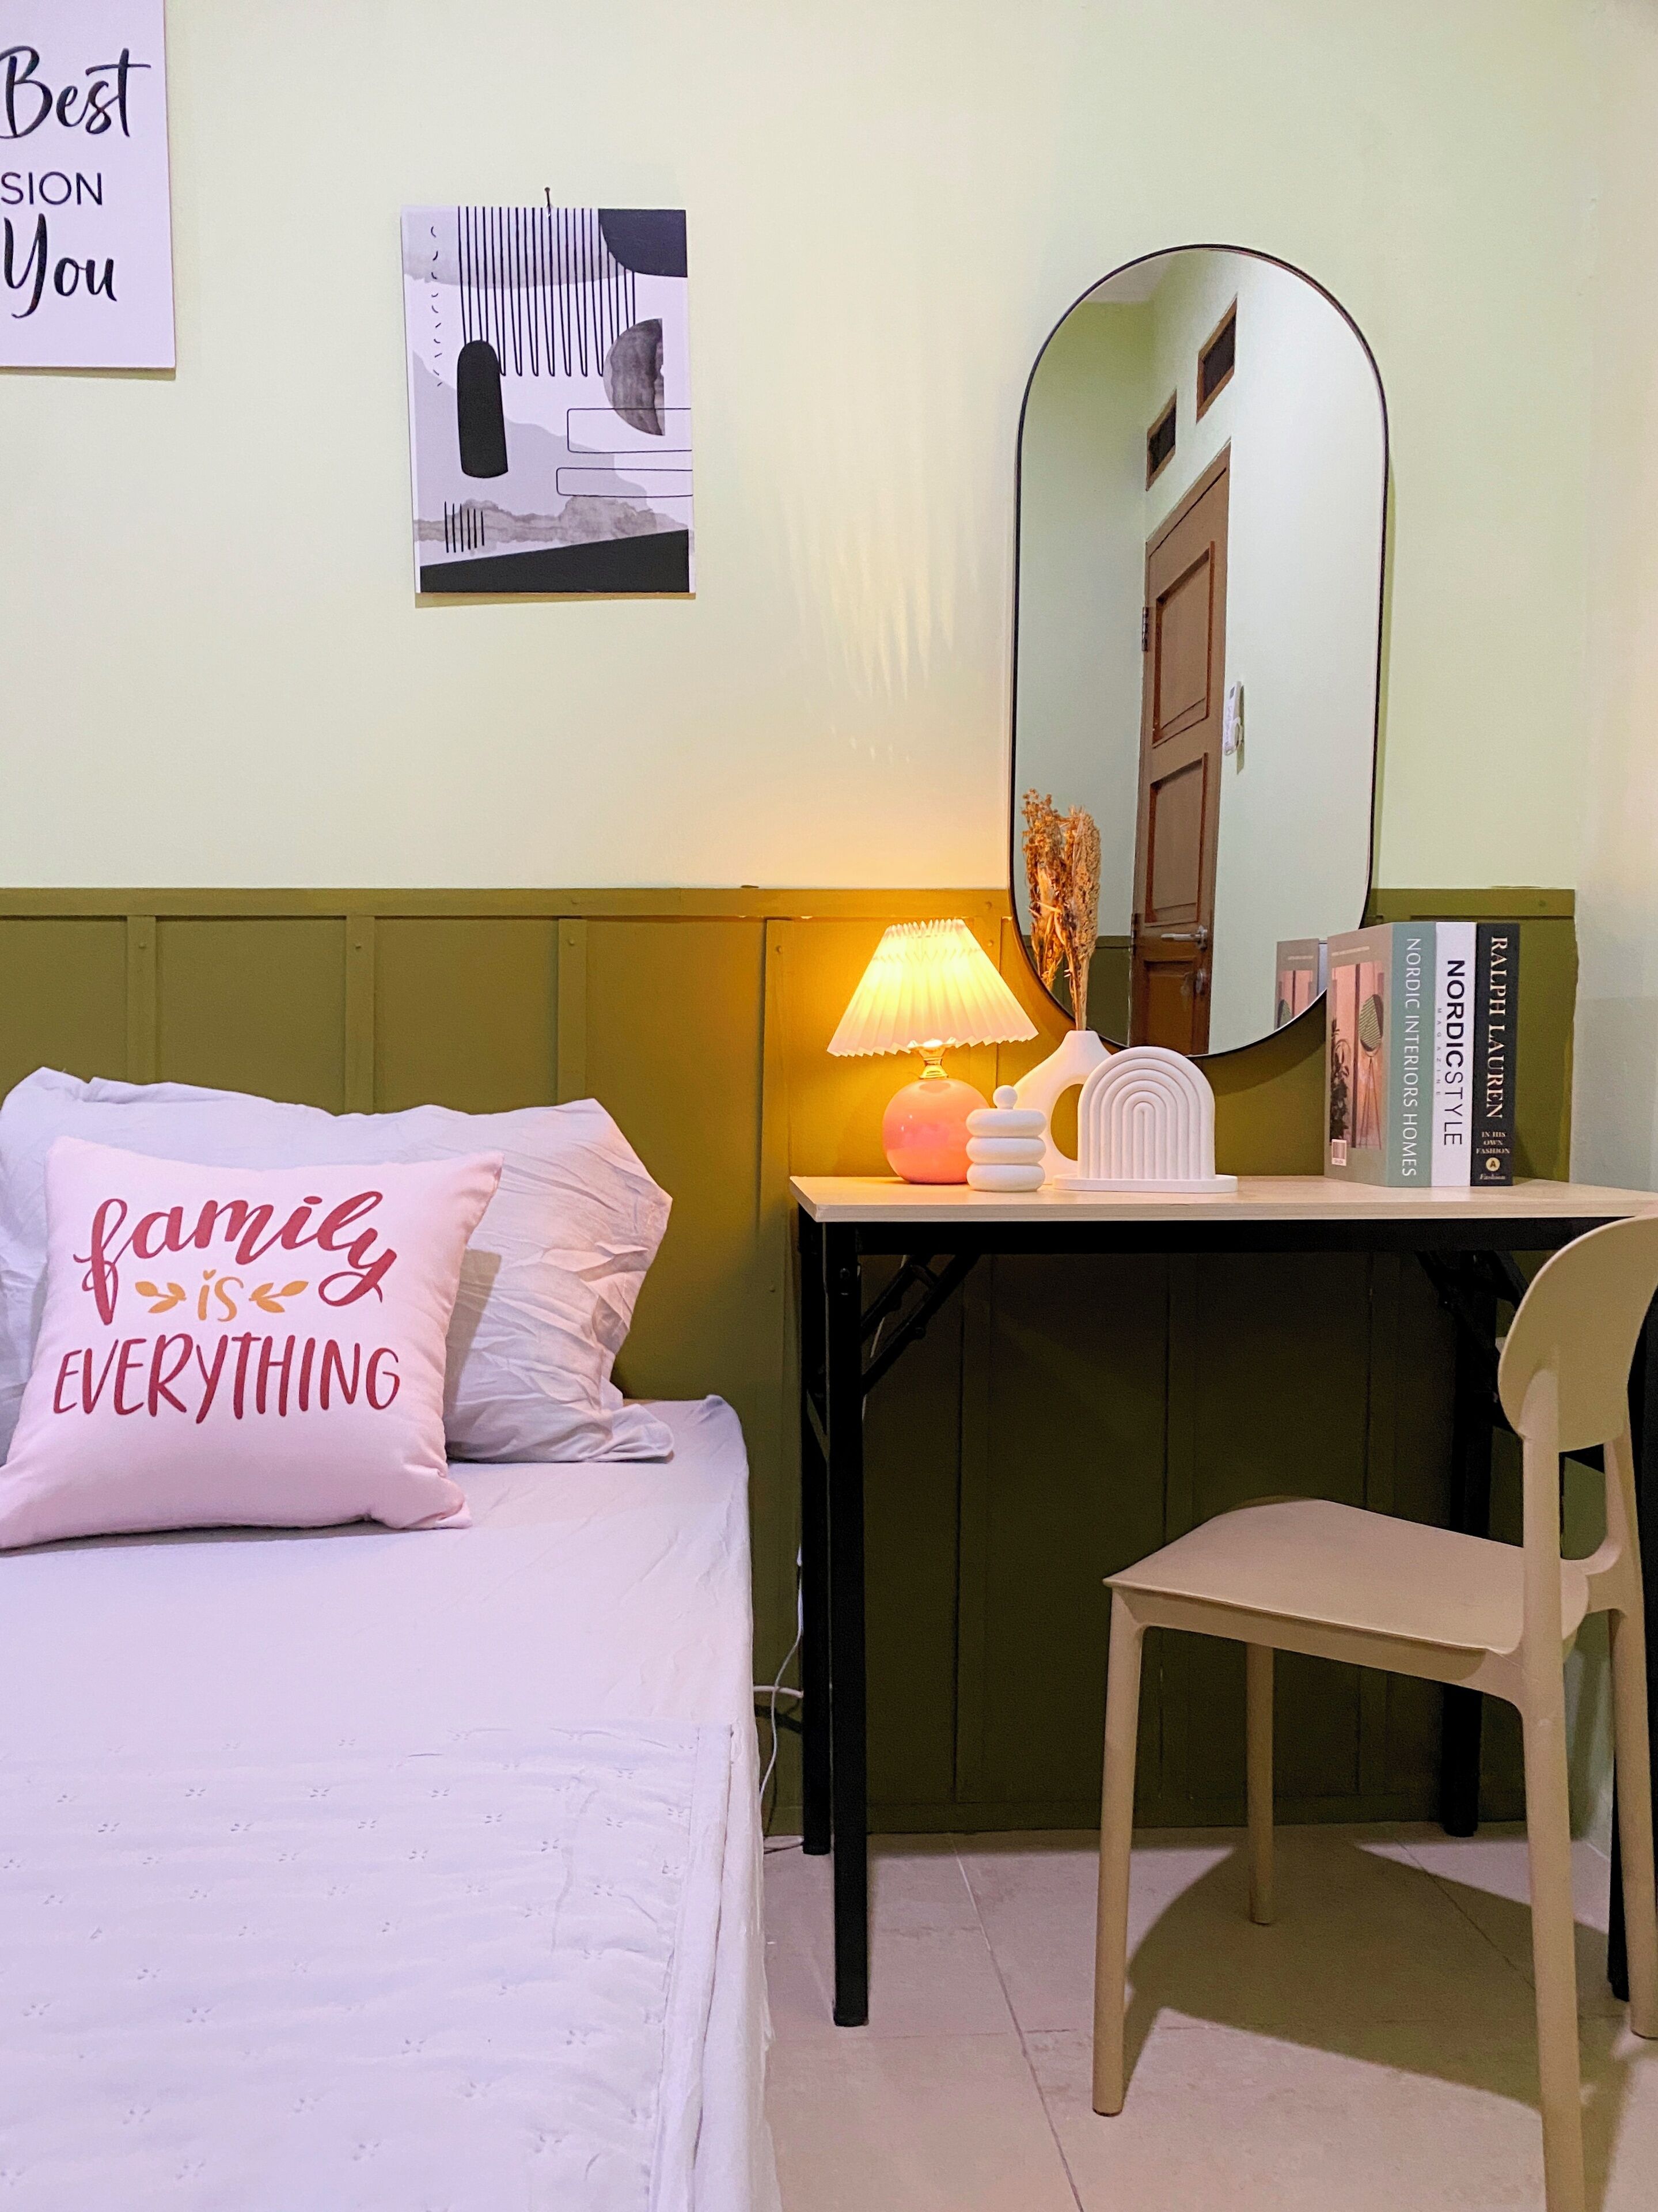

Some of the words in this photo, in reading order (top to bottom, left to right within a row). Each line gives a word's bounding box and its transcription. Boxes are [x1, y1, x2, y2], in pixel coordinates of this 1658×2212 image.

[0, 46, 151, 139] Best
[3, 213, 117, 319] You
[1405, 938, 1422, 1009] NORDIC
[1489, 936, 1508, 1016] RALPH
[1403, 1015, 1420, 1107] INTERIORS
[1486, 1024, 1505, 1119] LAUREN
[1402, 1113, 1418, 1177] HOMES
[73, 1191, 397, 1325] family
[196, 1270, 244, 1322] is
[53, 1331, 401, 1425] EVERYTHING
